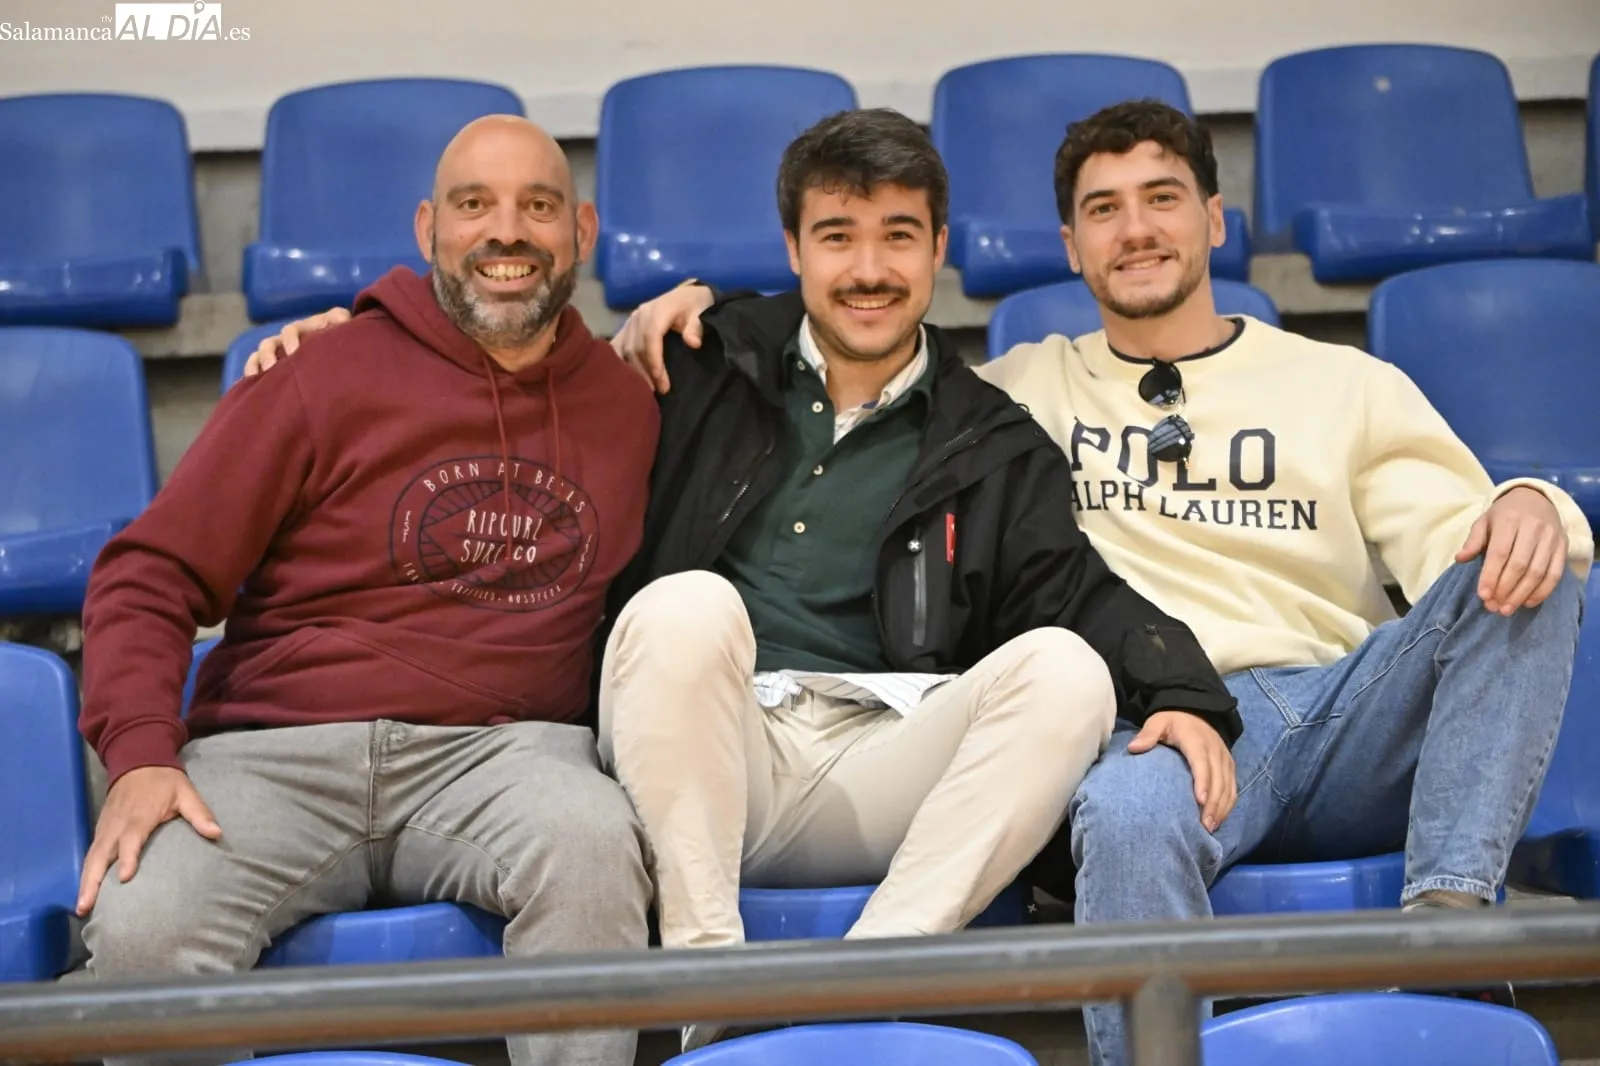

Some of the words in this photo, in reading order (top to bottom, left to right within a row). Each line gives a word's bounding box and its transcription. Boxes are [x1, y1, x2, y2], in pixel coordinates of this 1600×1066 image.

[1071, 416, 1276, 492] POLO
[423, 462, 480, 492] BORN
[497, 462, 520, 477] AT
[535, 469, 586, 513] BELS
[1072, 480, 1147, 512] ALPH
[1159, 495, 1318, 531] LAUREN
[512, 545, 537, 564] CO
